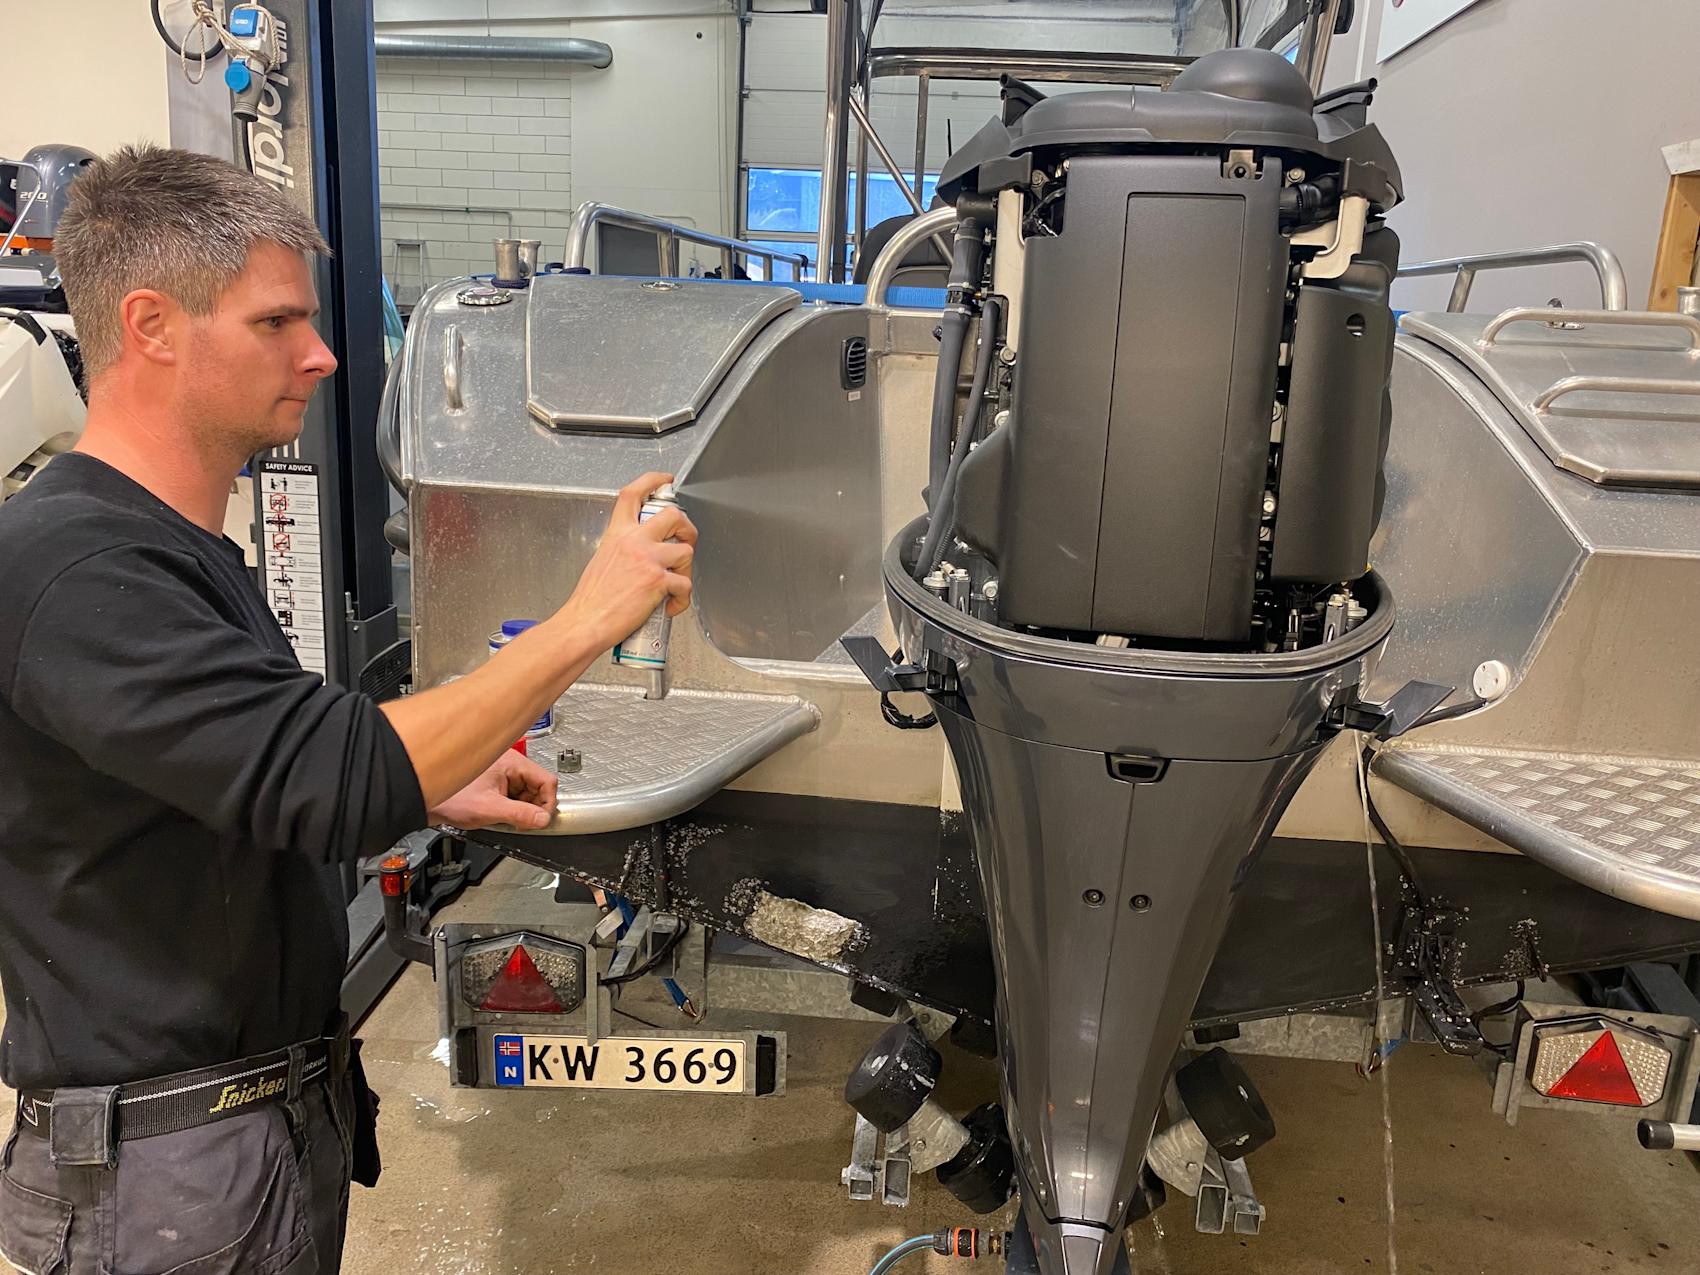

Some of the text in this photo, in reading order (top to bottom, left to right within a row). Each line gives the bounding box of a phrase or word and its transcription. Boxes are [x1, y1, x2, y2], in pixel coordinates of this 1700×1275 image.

[265, 462, 313, 473] SAFETY ADVICE
[625, 1046, 737, 1085] 3669
[504, 1066, 517, 1078] N
